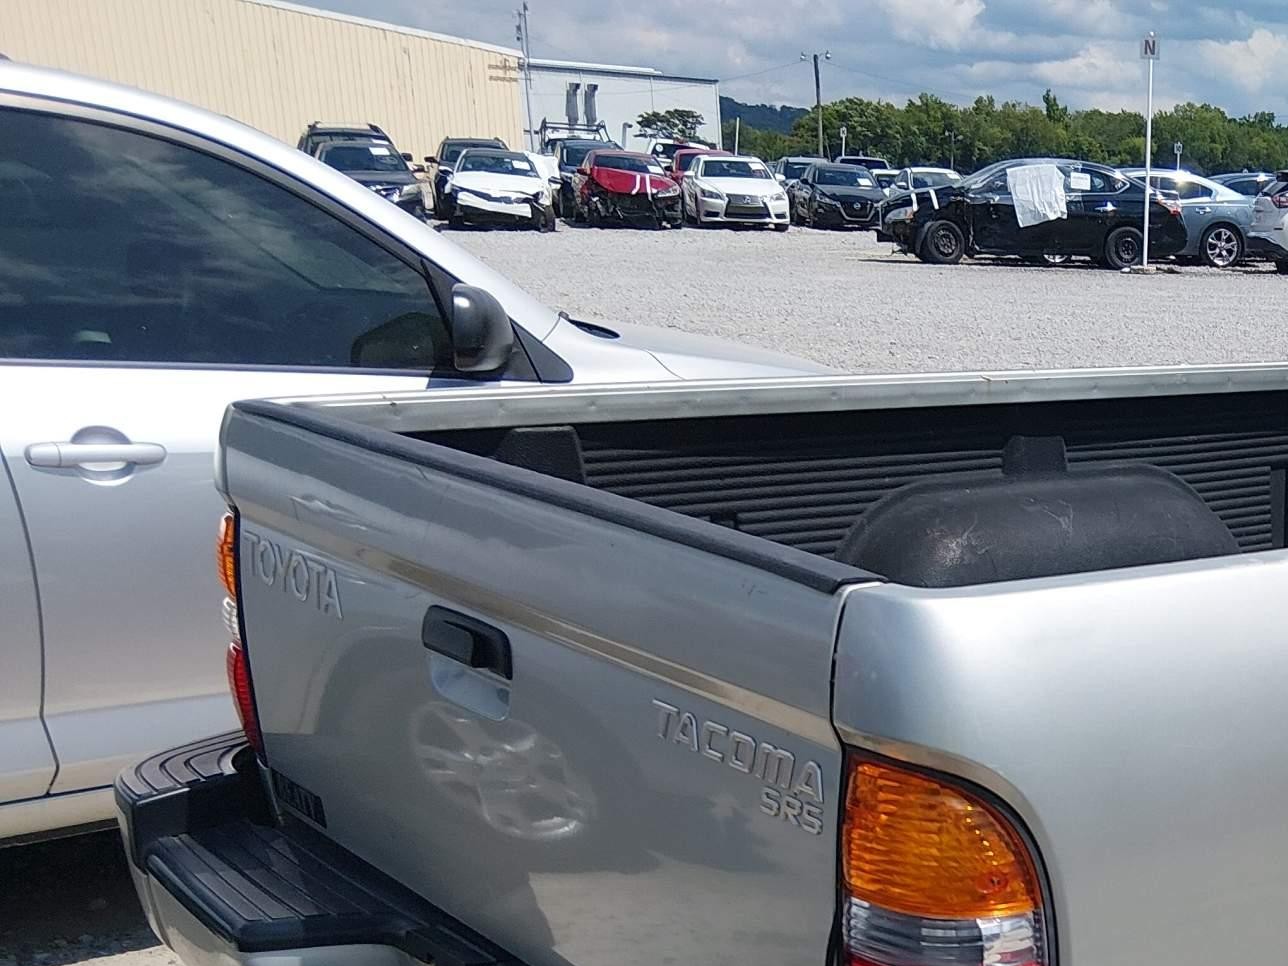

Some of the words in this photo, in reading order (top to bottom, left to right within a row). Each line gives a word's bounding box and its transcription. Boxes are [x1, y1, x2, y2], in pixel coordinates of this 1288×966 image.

[1144, 40, 1156, 56] N
[242, 529, 345, 622] TOYOTA
[651, 697, 825, 805] TACOMA
